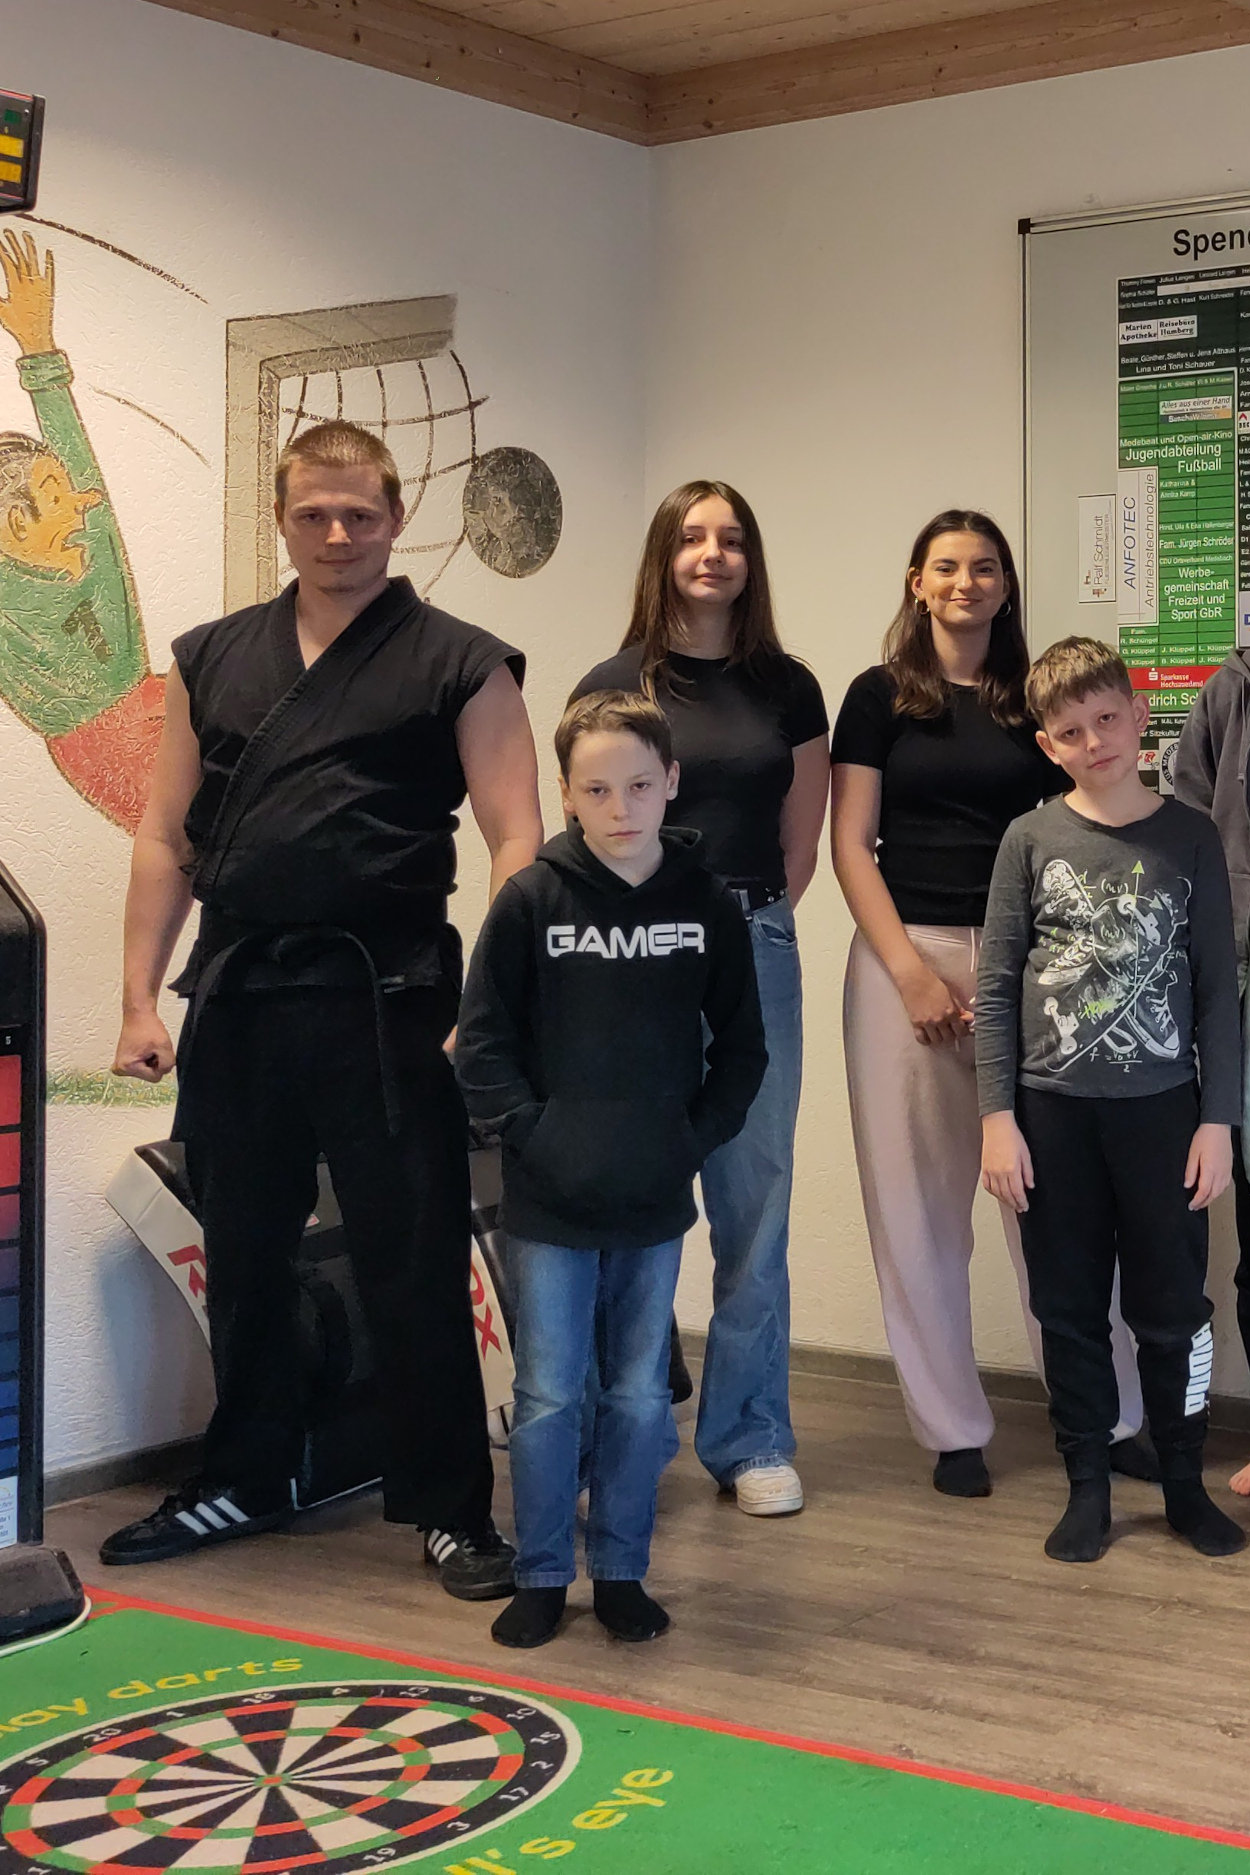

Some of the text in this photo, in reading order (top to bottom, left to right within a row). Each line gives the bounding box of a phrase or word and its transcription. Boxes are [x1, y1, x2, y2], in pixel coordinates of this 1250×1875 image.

[1126, 323, 1152, 331] Marien
[1160, 318, 1195, 328] Reisebüro
[1121, 331, 1157, 341] Apotheke
[1212, 396, 1230, 404] Hand
[1126, 444, 1222, 462] Jugendabteilung
[1178, 458, 1222, 473] Fußball
[1123, 496, 1136, 589] ANFOTEC
[1145, 473, 1157, 608] Antriebstechnologie
[1159, 536, 1234, 550] Fam. Jürgen Schröder
[1179, 568, 1214, 578] Werbe-
[1165, 579, 1229, 595] gemeinschaft
[1169, 593, 1225, 606] Freizeit und
[1171, 607, 1222, 621] Sport GbR
[1160, 673, 1190, 681] Sparkasse
[1160, 680, 1203, 688] Hochsauerland
[547, 922, 705, 959] GAMER
[0, 1657, 303, 1740] lay darts
[506, 1706, 538, 1722] 10
[83, 1727, 123, 1744] 20
[531, 1728, 562, 1746] 15
[531, 1760, 555, 1772] 2
[499, 1786, 529, 1804] 17
[572, 1765, 675, 1831] eye
[447, 1820, 471, 1833] 3
[362, 1846, 398, 1866] 19
